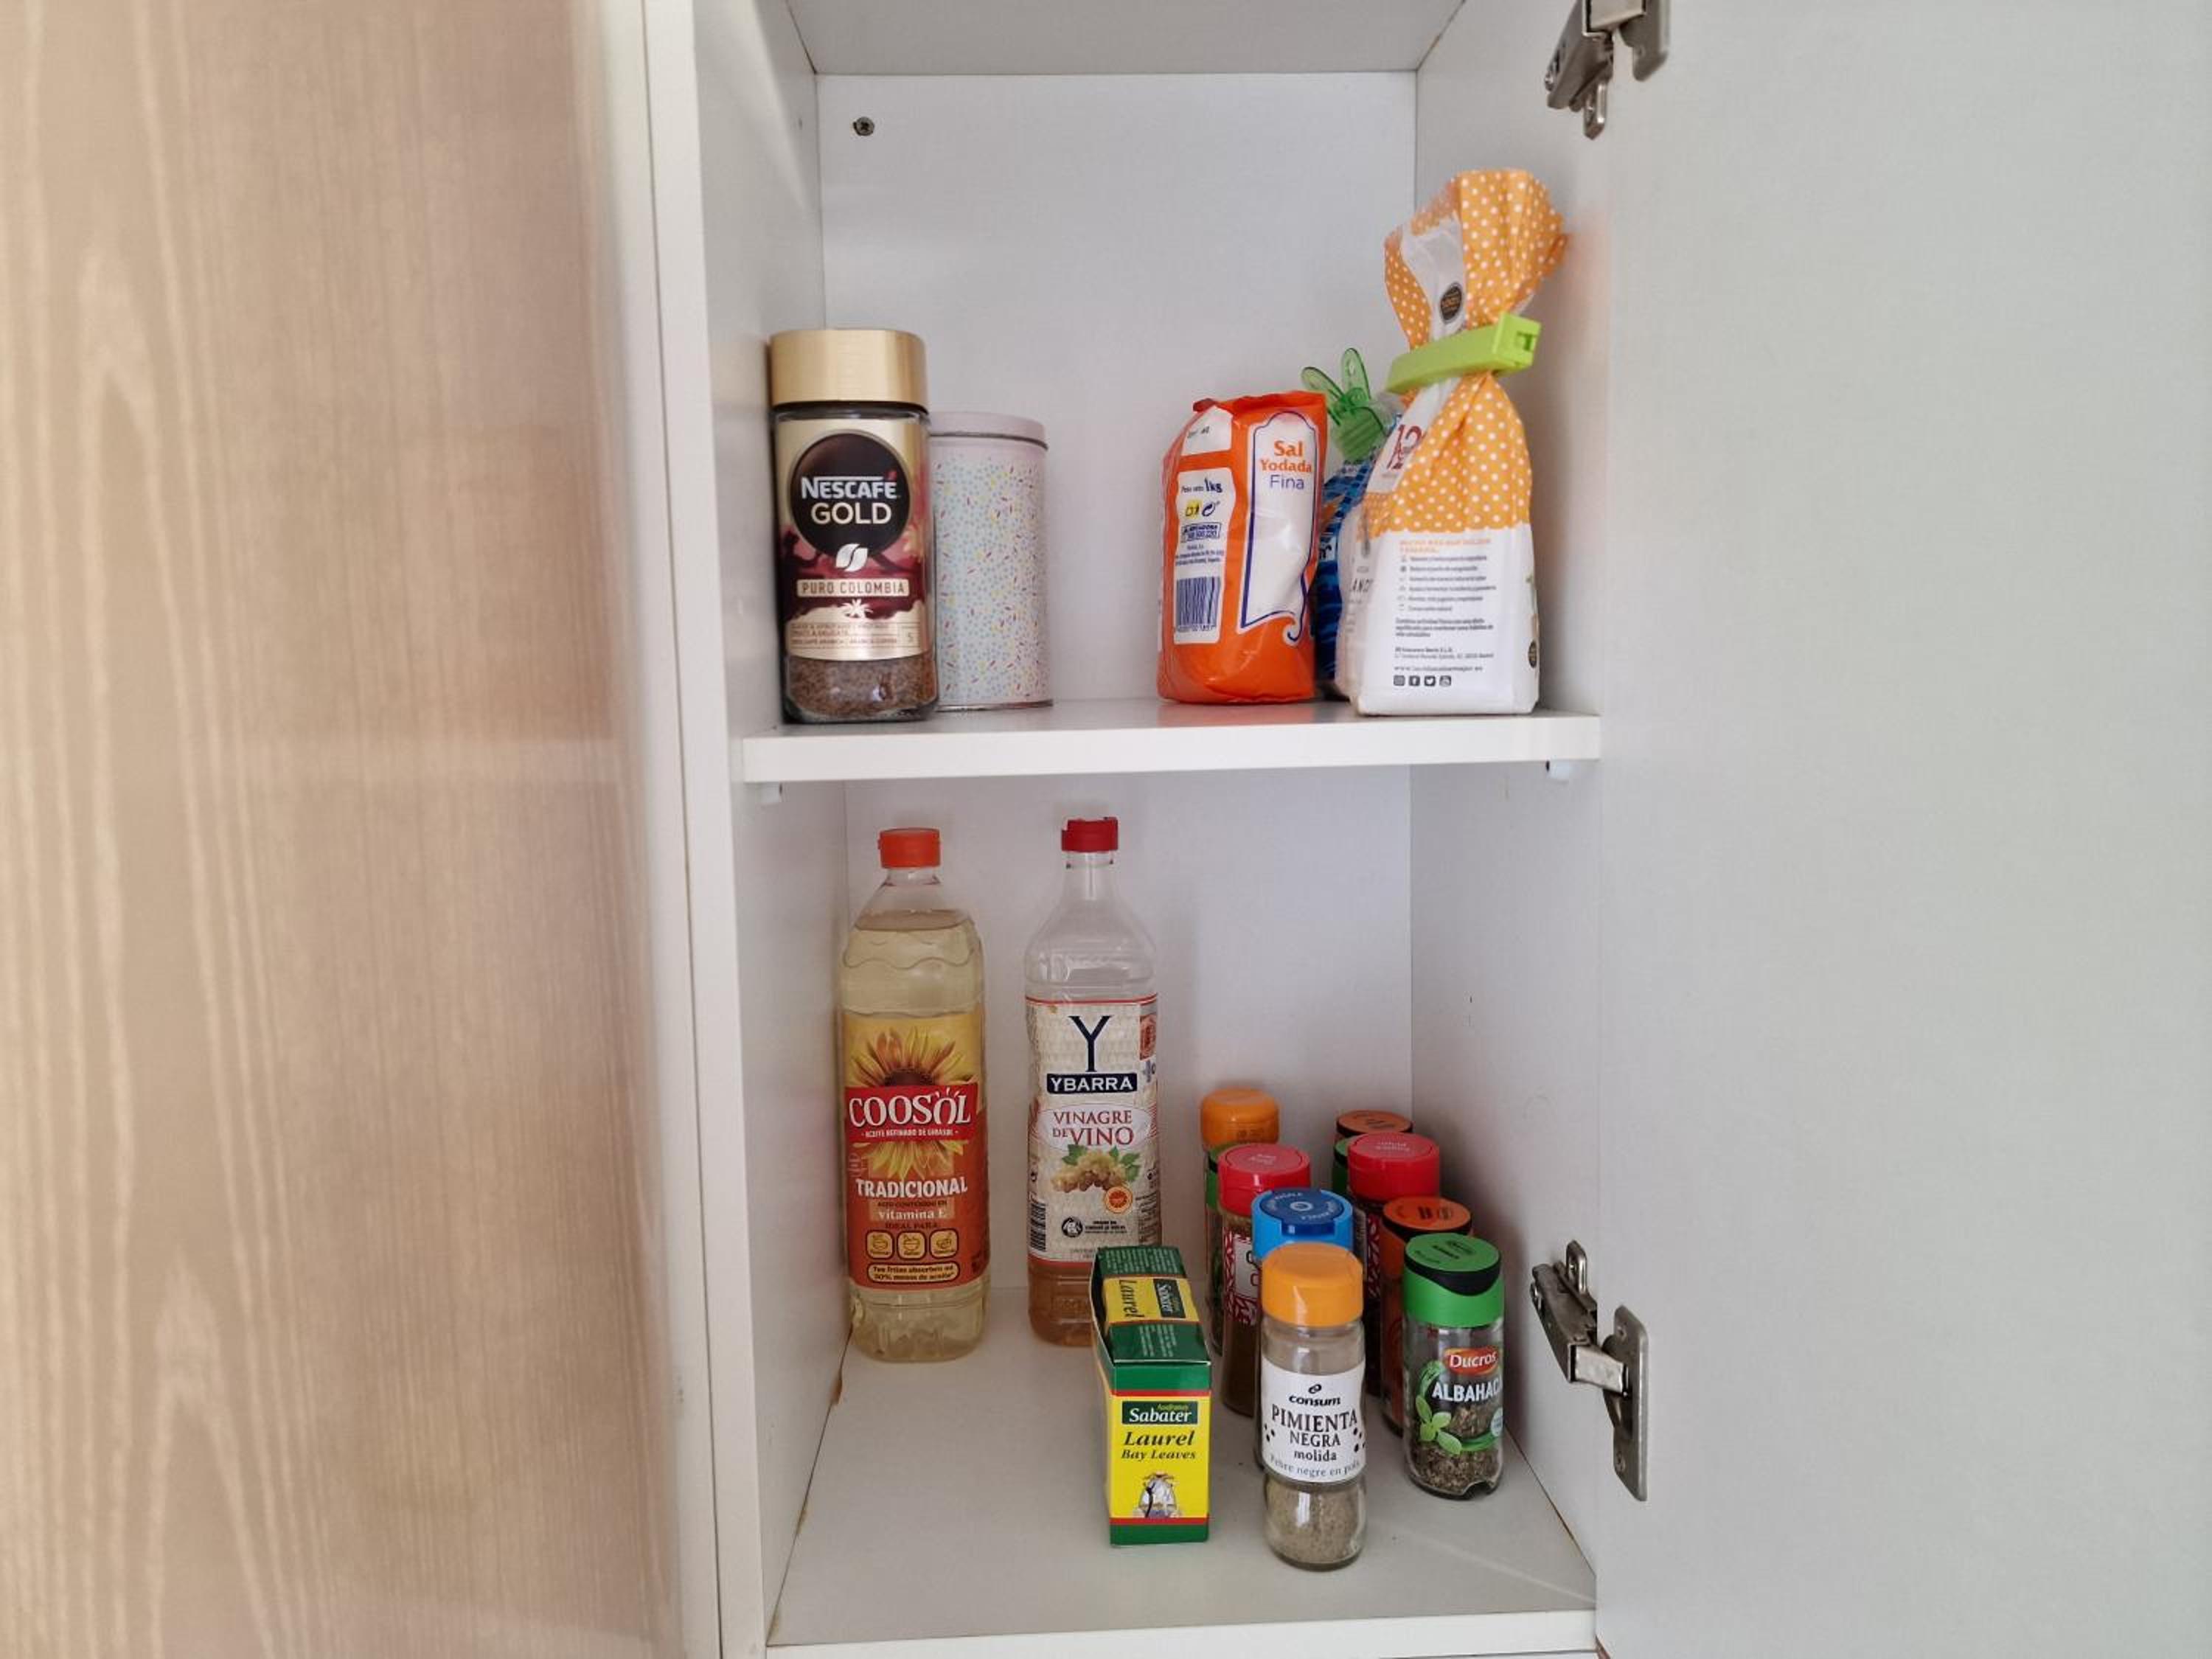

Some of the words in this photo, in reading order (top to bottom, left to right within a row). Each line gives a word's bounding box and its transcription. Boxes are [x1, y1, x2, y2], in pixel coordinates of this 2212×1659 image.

[1274, 441, 1303, 456] Sal
[1261, 459, 1312, 473] Yodada
[1270, 474, 1304, 490] Fina
[812, 502, 891, 524] GOLD
[801, 582, 834, 594] PURO
[839, 581, 905, 594] COLOMBIA
[1067, 1015, 1114, 1072] Y
[1050, 1077, 1133, 1091] YBARRA
[1053, 1110, 1133, 1124] VINAGRE
[1052, 1127, 1068, 1138] DE
[1068, 1127, 1135, 1145] VINO
[855, 1176, 968, 1198] TRADICIONAL
[878, 1209, 934, 1220] vitamina
[1119, 1279, 1144, 1318] Laurel
[1449, 1351, 1498, 1368] Ducros
[1288, 1394, 1341, 1407] consum
[1129, 1408, 1192, 1422] Sabater
[1271, 1404, 1357, 1433] PIMIENTA
[1124, 1430, 1195, 1446] Laurel
[1290, 1430, 1341, 1447] NEGRA
[1121, 1449, 1147, 1461] Bay
[1151, 1449, 1196, 1459] Leaves
[1294, 1450, 1337, 1462] molida
